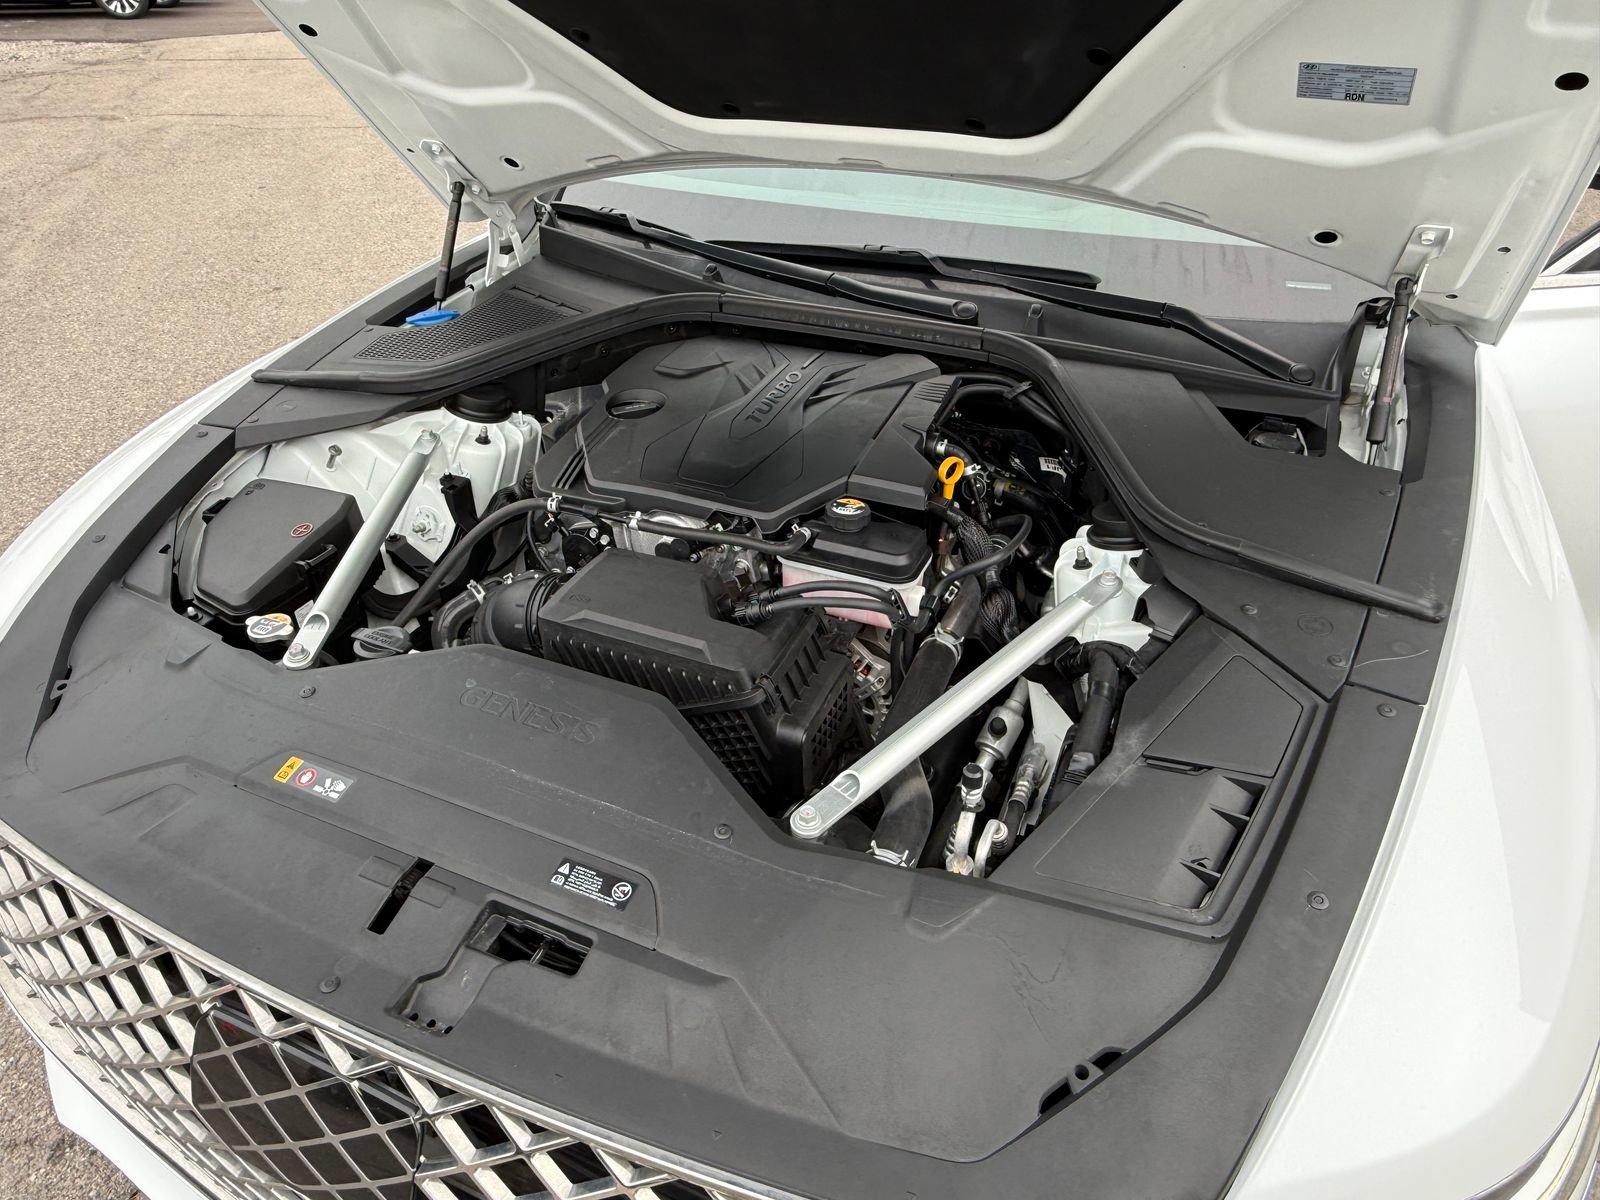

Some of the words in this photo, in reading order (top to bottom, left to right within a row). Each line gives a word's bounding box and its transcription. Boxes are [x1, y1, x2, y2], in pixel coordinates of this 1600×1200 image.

[1344, 92, 1366, 102] RDN
[745, 371, 802, 424] TURBO
[363, 633, 392, 644] COOLANT
[459, 686, 602, 745] GENESIS
